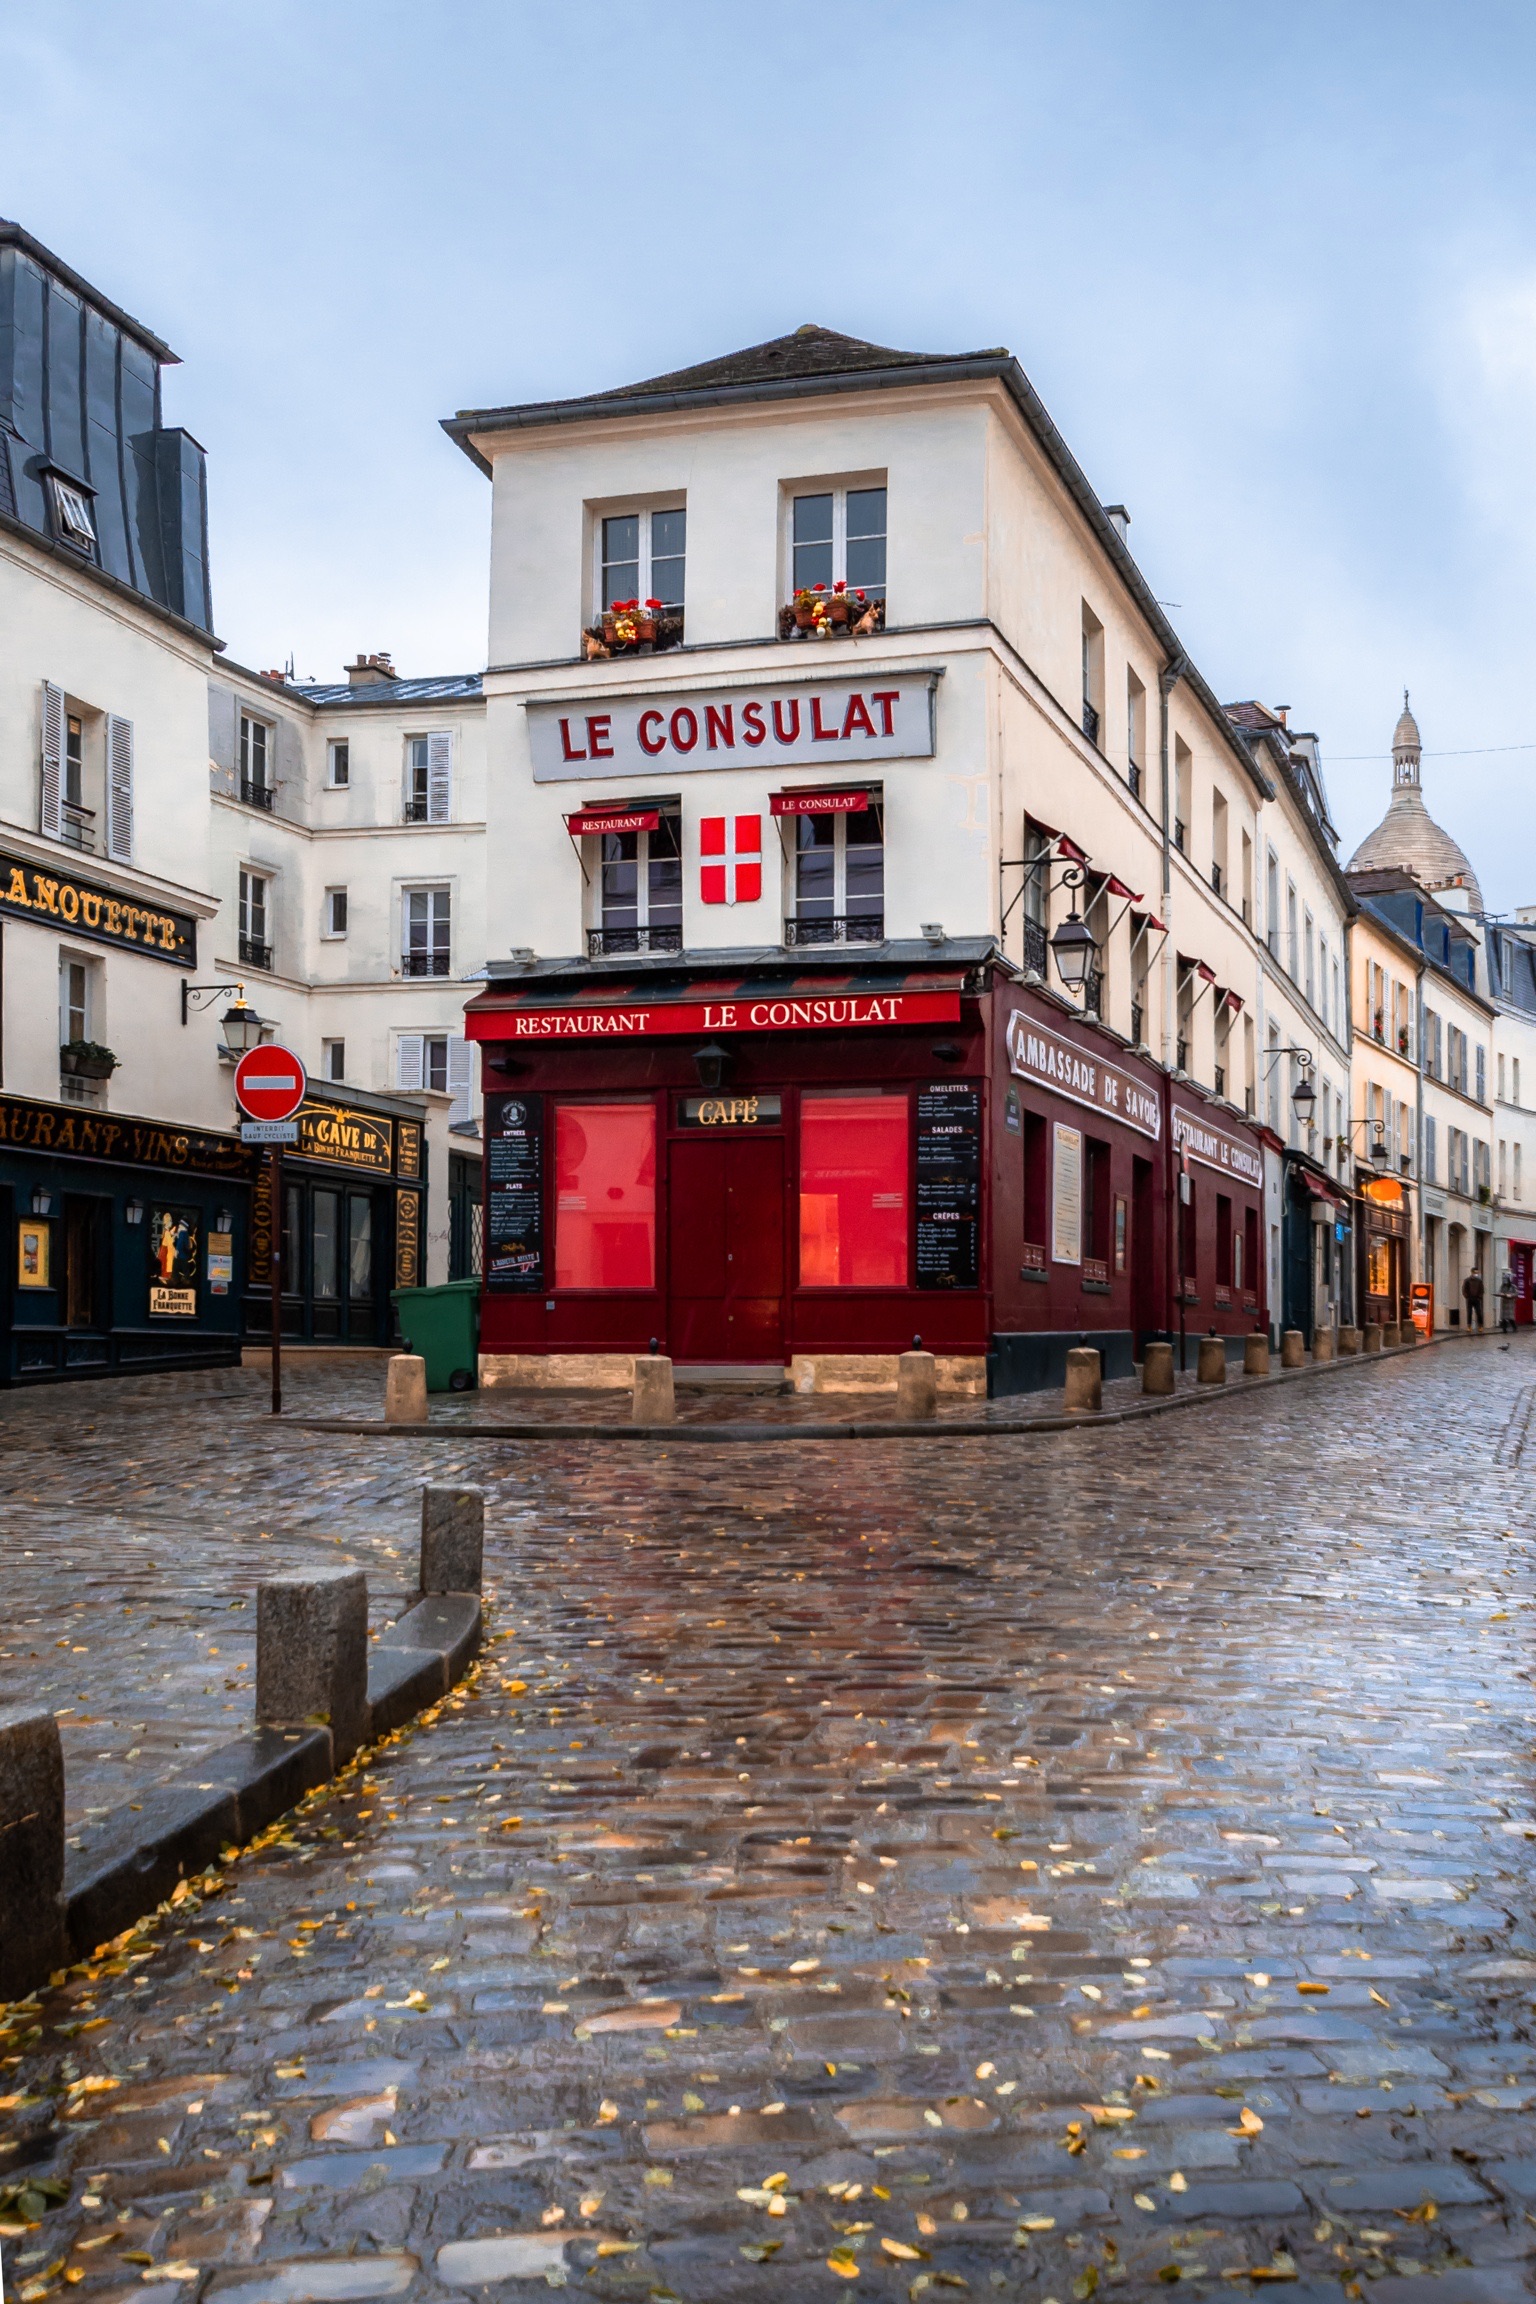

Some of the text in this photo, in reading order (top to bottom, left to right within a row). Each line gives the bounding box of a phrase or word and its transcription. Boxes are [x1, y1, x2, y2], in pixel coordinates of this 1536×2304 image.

[558, 691, 901, 762] LE CONSULAT
[782, 797, 856, 811] LE CONSULAT
[581, 816, 645, 831] RESTAURANT
[0, 868, 177, 950] ANQUETTE
[515, 997, 903, 1035] RESTAURANT LE CONSULAT
[1016, 1029, 1157, 1129] AMBASSADE DE SAVOIE
[929, 1084, 969, 1093] OMELETTES
[698, 1096, 759, 1125] CAFÉ
[244, 1132, 295, 1140] SAUF CYCLISTE
[253, 1125, 285, 1133] INTERDIT
[302, 1119, 377, 1150] LA CAVE DE
[931, 1126, 963, 1134] SALADES
[301, 1140, 376, 1164] LA BONNE FRANQUETTE
[1220, 1141, 1229, 1165] LE
[932, 1212, 960, 1221] CRÊPES
[157, 1289, 189, 1301] LA BONNE
[153, 1299, 193, 1312] FRANQUETTE
